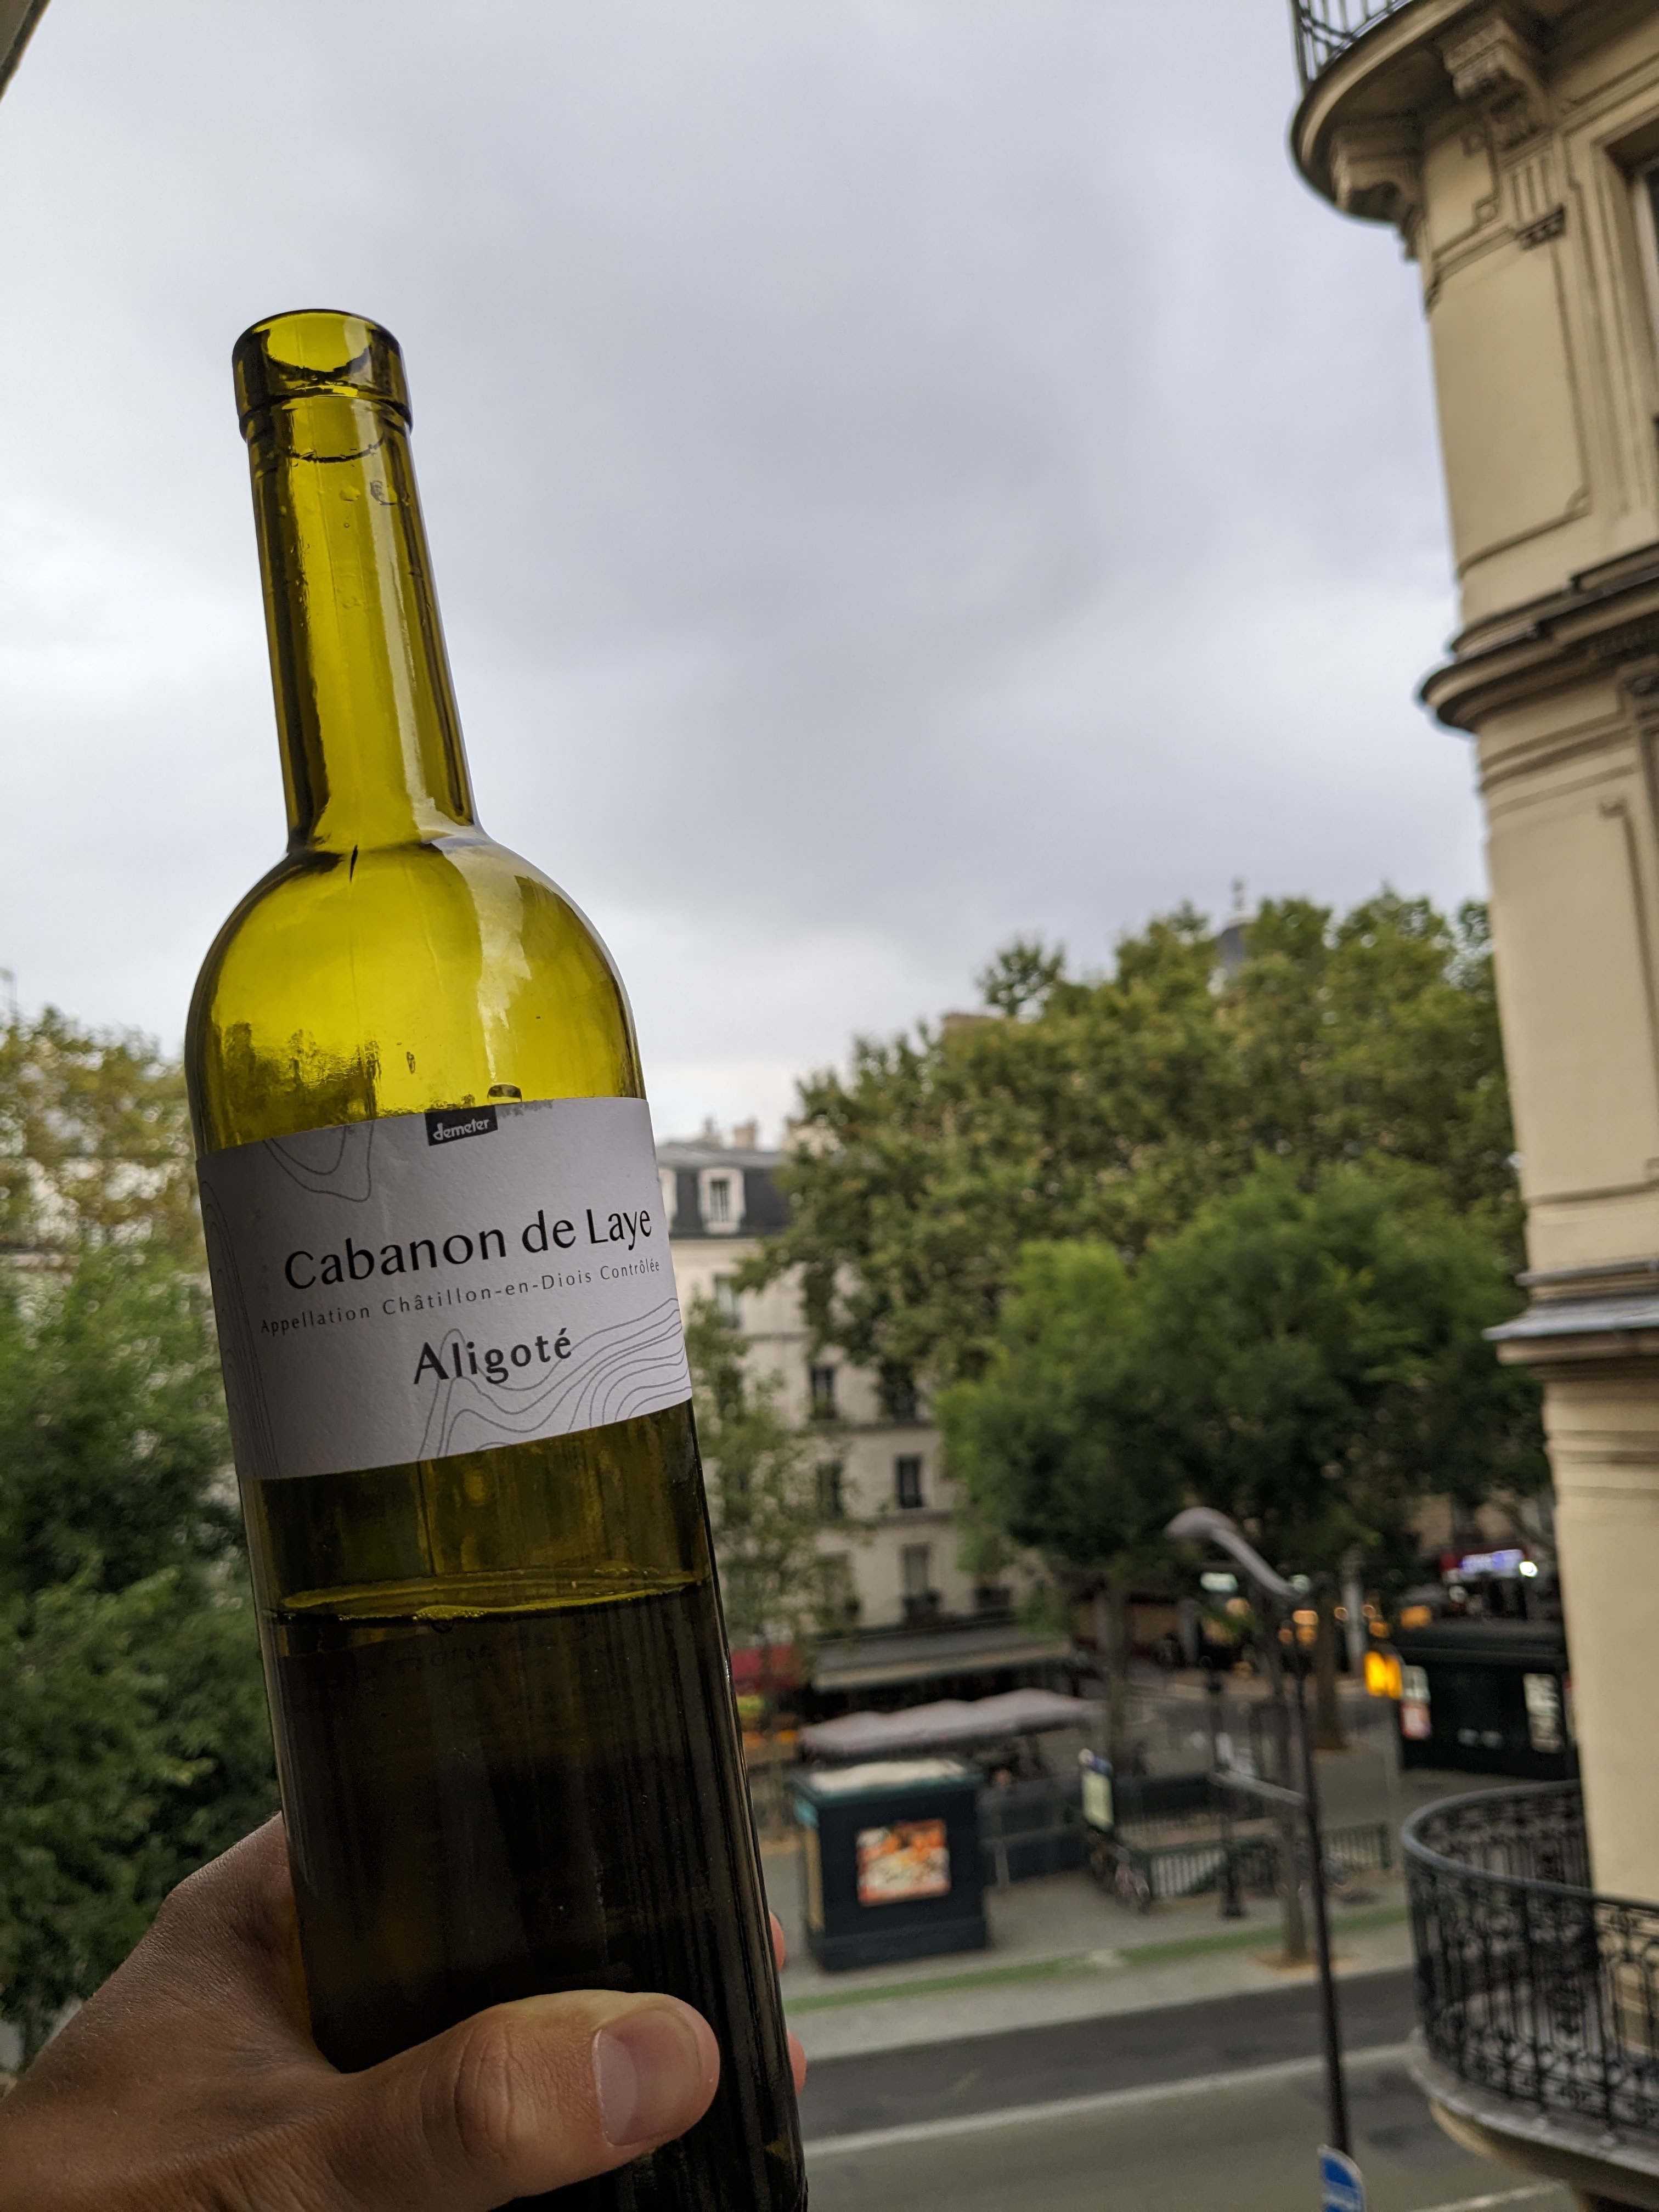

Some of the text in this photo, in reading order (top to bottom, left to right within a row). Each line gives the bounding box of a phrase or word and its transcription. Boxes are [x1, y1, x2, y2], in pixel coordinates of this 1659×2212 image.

[432, 1117, 489, 1142] demeter
[284, 1209, 652, 1290] Cabanon de Laye
[260, 1259, 659, 1336] Appellation Châtillon-en-Diois Contrôlée
[413, 1329, 573, 1385] Aligoté
